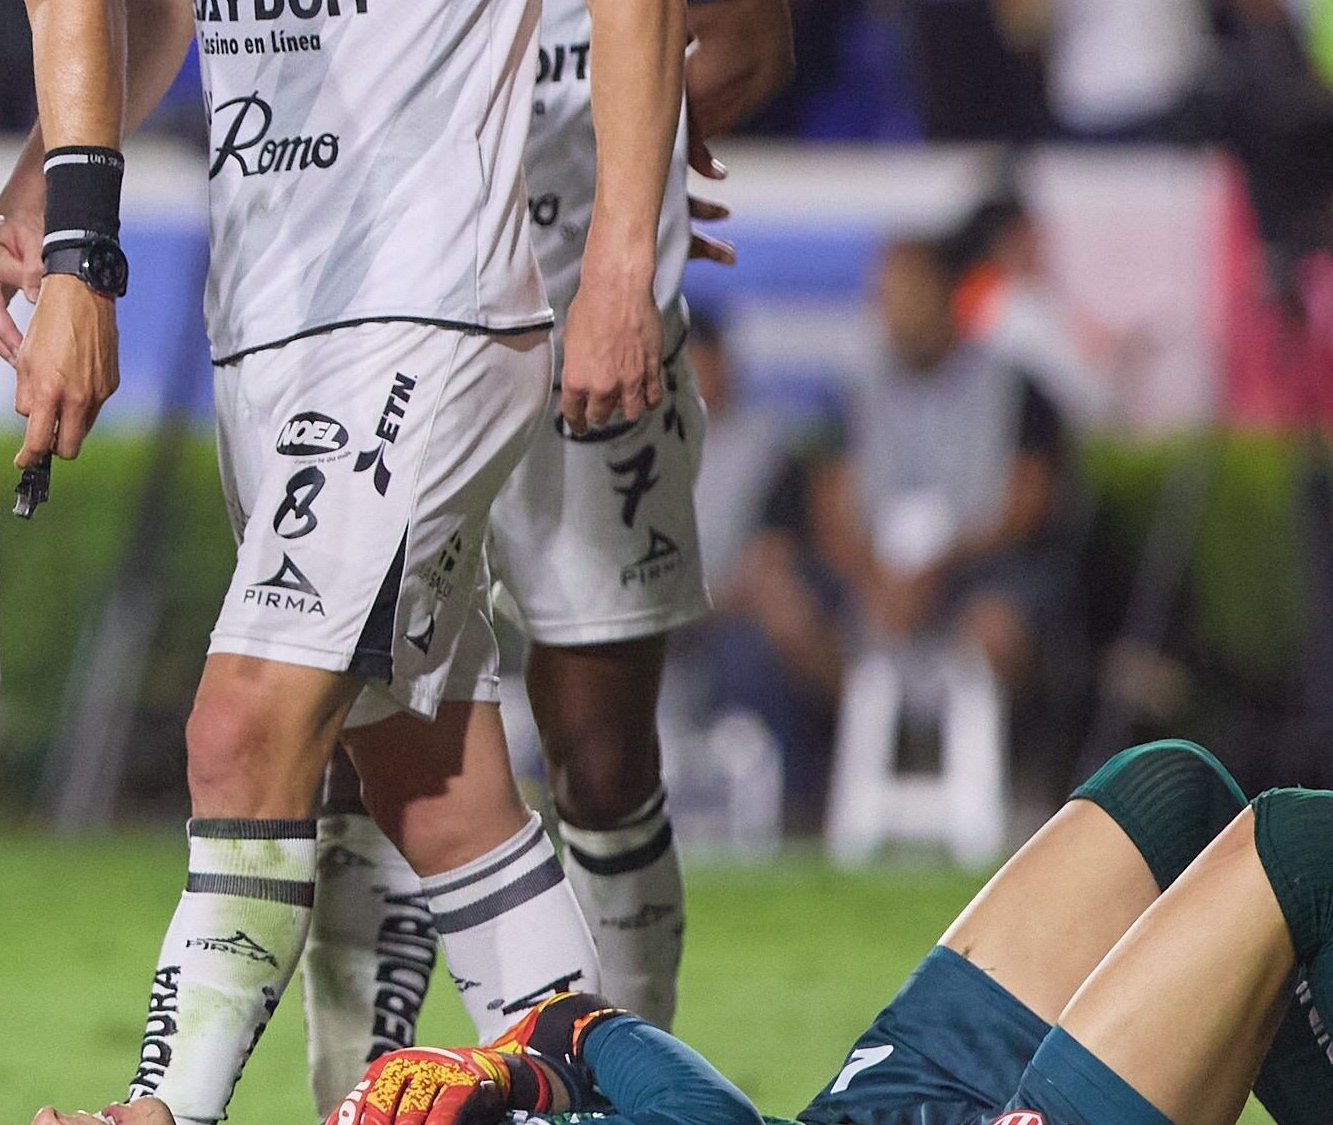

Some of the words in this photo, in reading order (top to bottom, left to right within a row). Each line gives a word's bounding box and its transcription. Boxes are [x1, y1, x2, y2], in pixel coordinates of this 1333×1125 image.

[245, 35, 266, 55] en
[271, 30, 322, 53] Línea
[209, 90, 340, 181] Romo
[276, 419, 341, 450] NOEL
[375, 371, 413, 445] ETN
[272, 464, 327, 540] 8
[605, 442, 663, 529] 7
[243, 588, 327, 617] PIRMA
